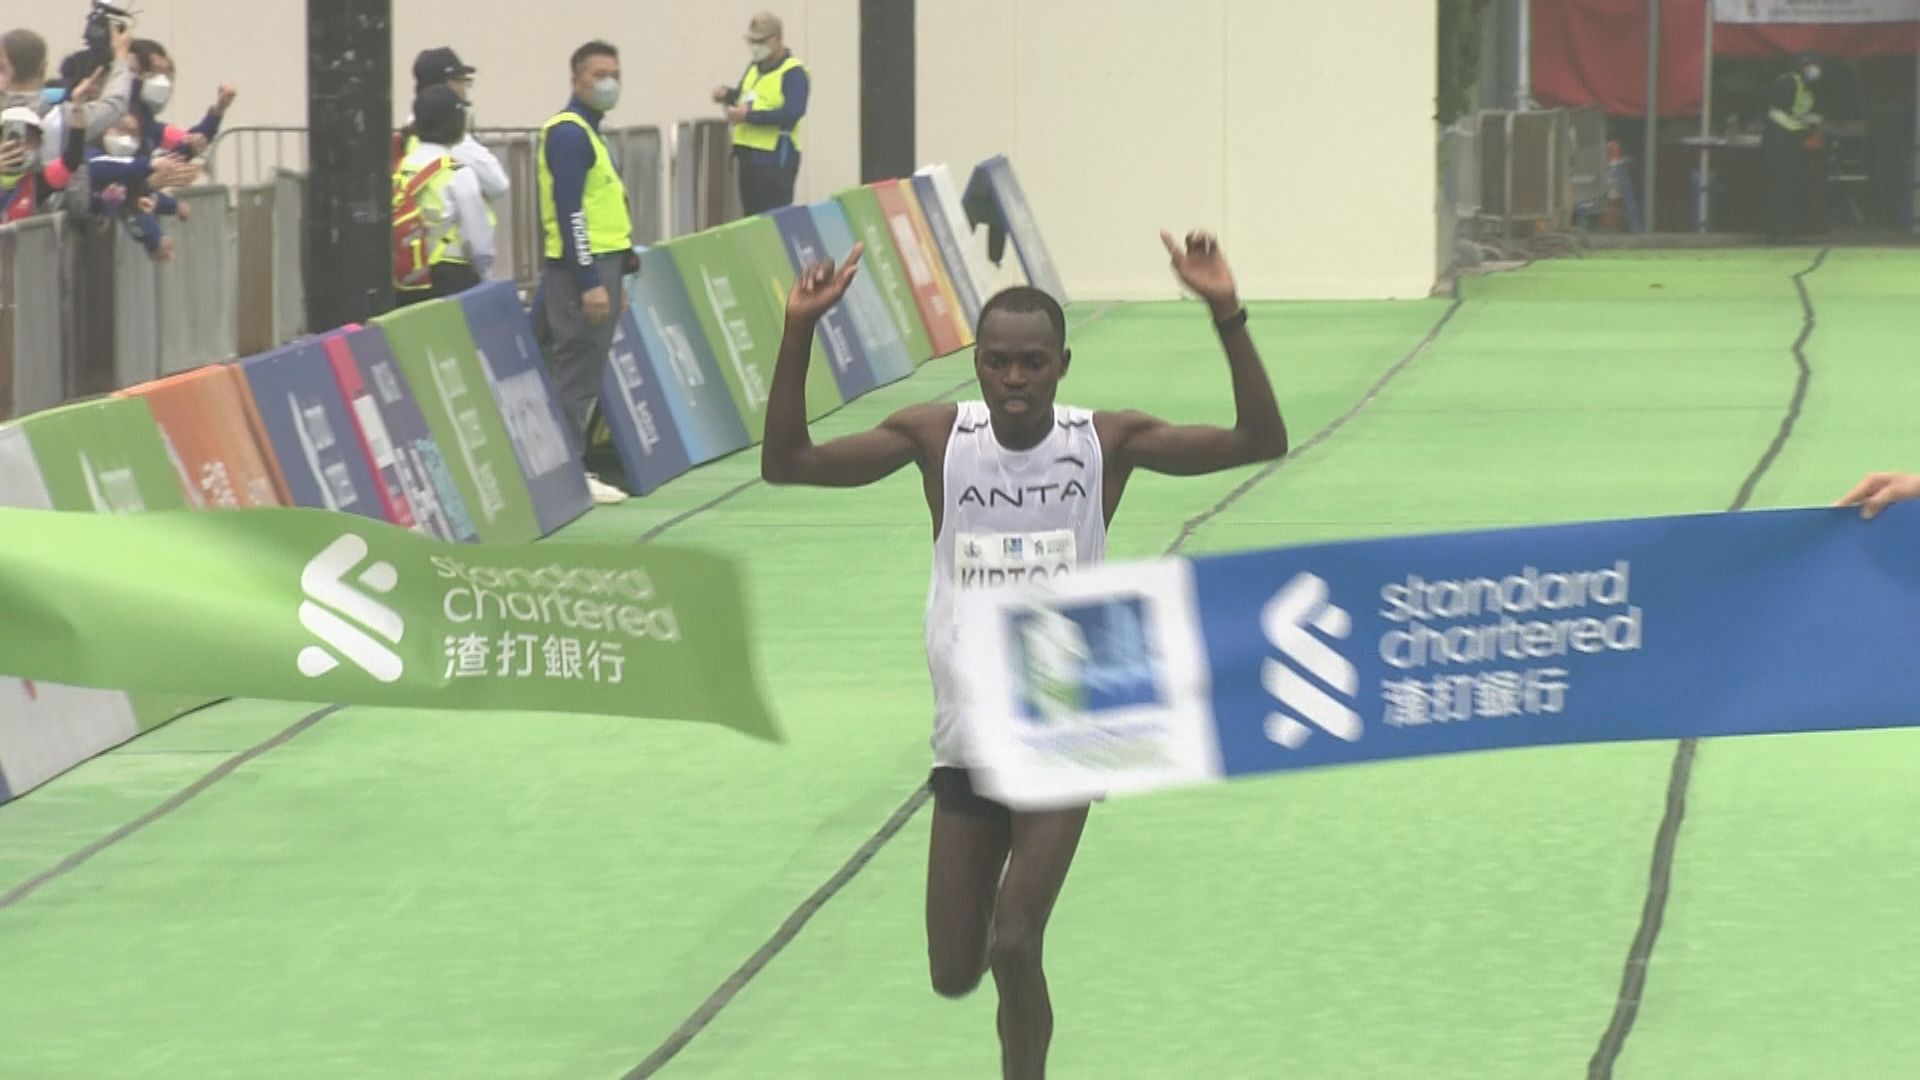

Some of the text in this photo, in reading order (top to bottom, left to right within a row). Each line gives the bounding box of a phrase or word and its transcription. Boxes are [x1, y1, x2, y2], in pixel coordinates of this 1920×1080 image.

[958, 479, 1087, 507] ANTA
[430, 555, 655, 600] standard
[1380, 560, 1630, 622] standard
[443, 582, 682, 642] chartered
[1378, 605, 1643, 670] chartered
[443, 631, 625, 683] 渣打銀行
